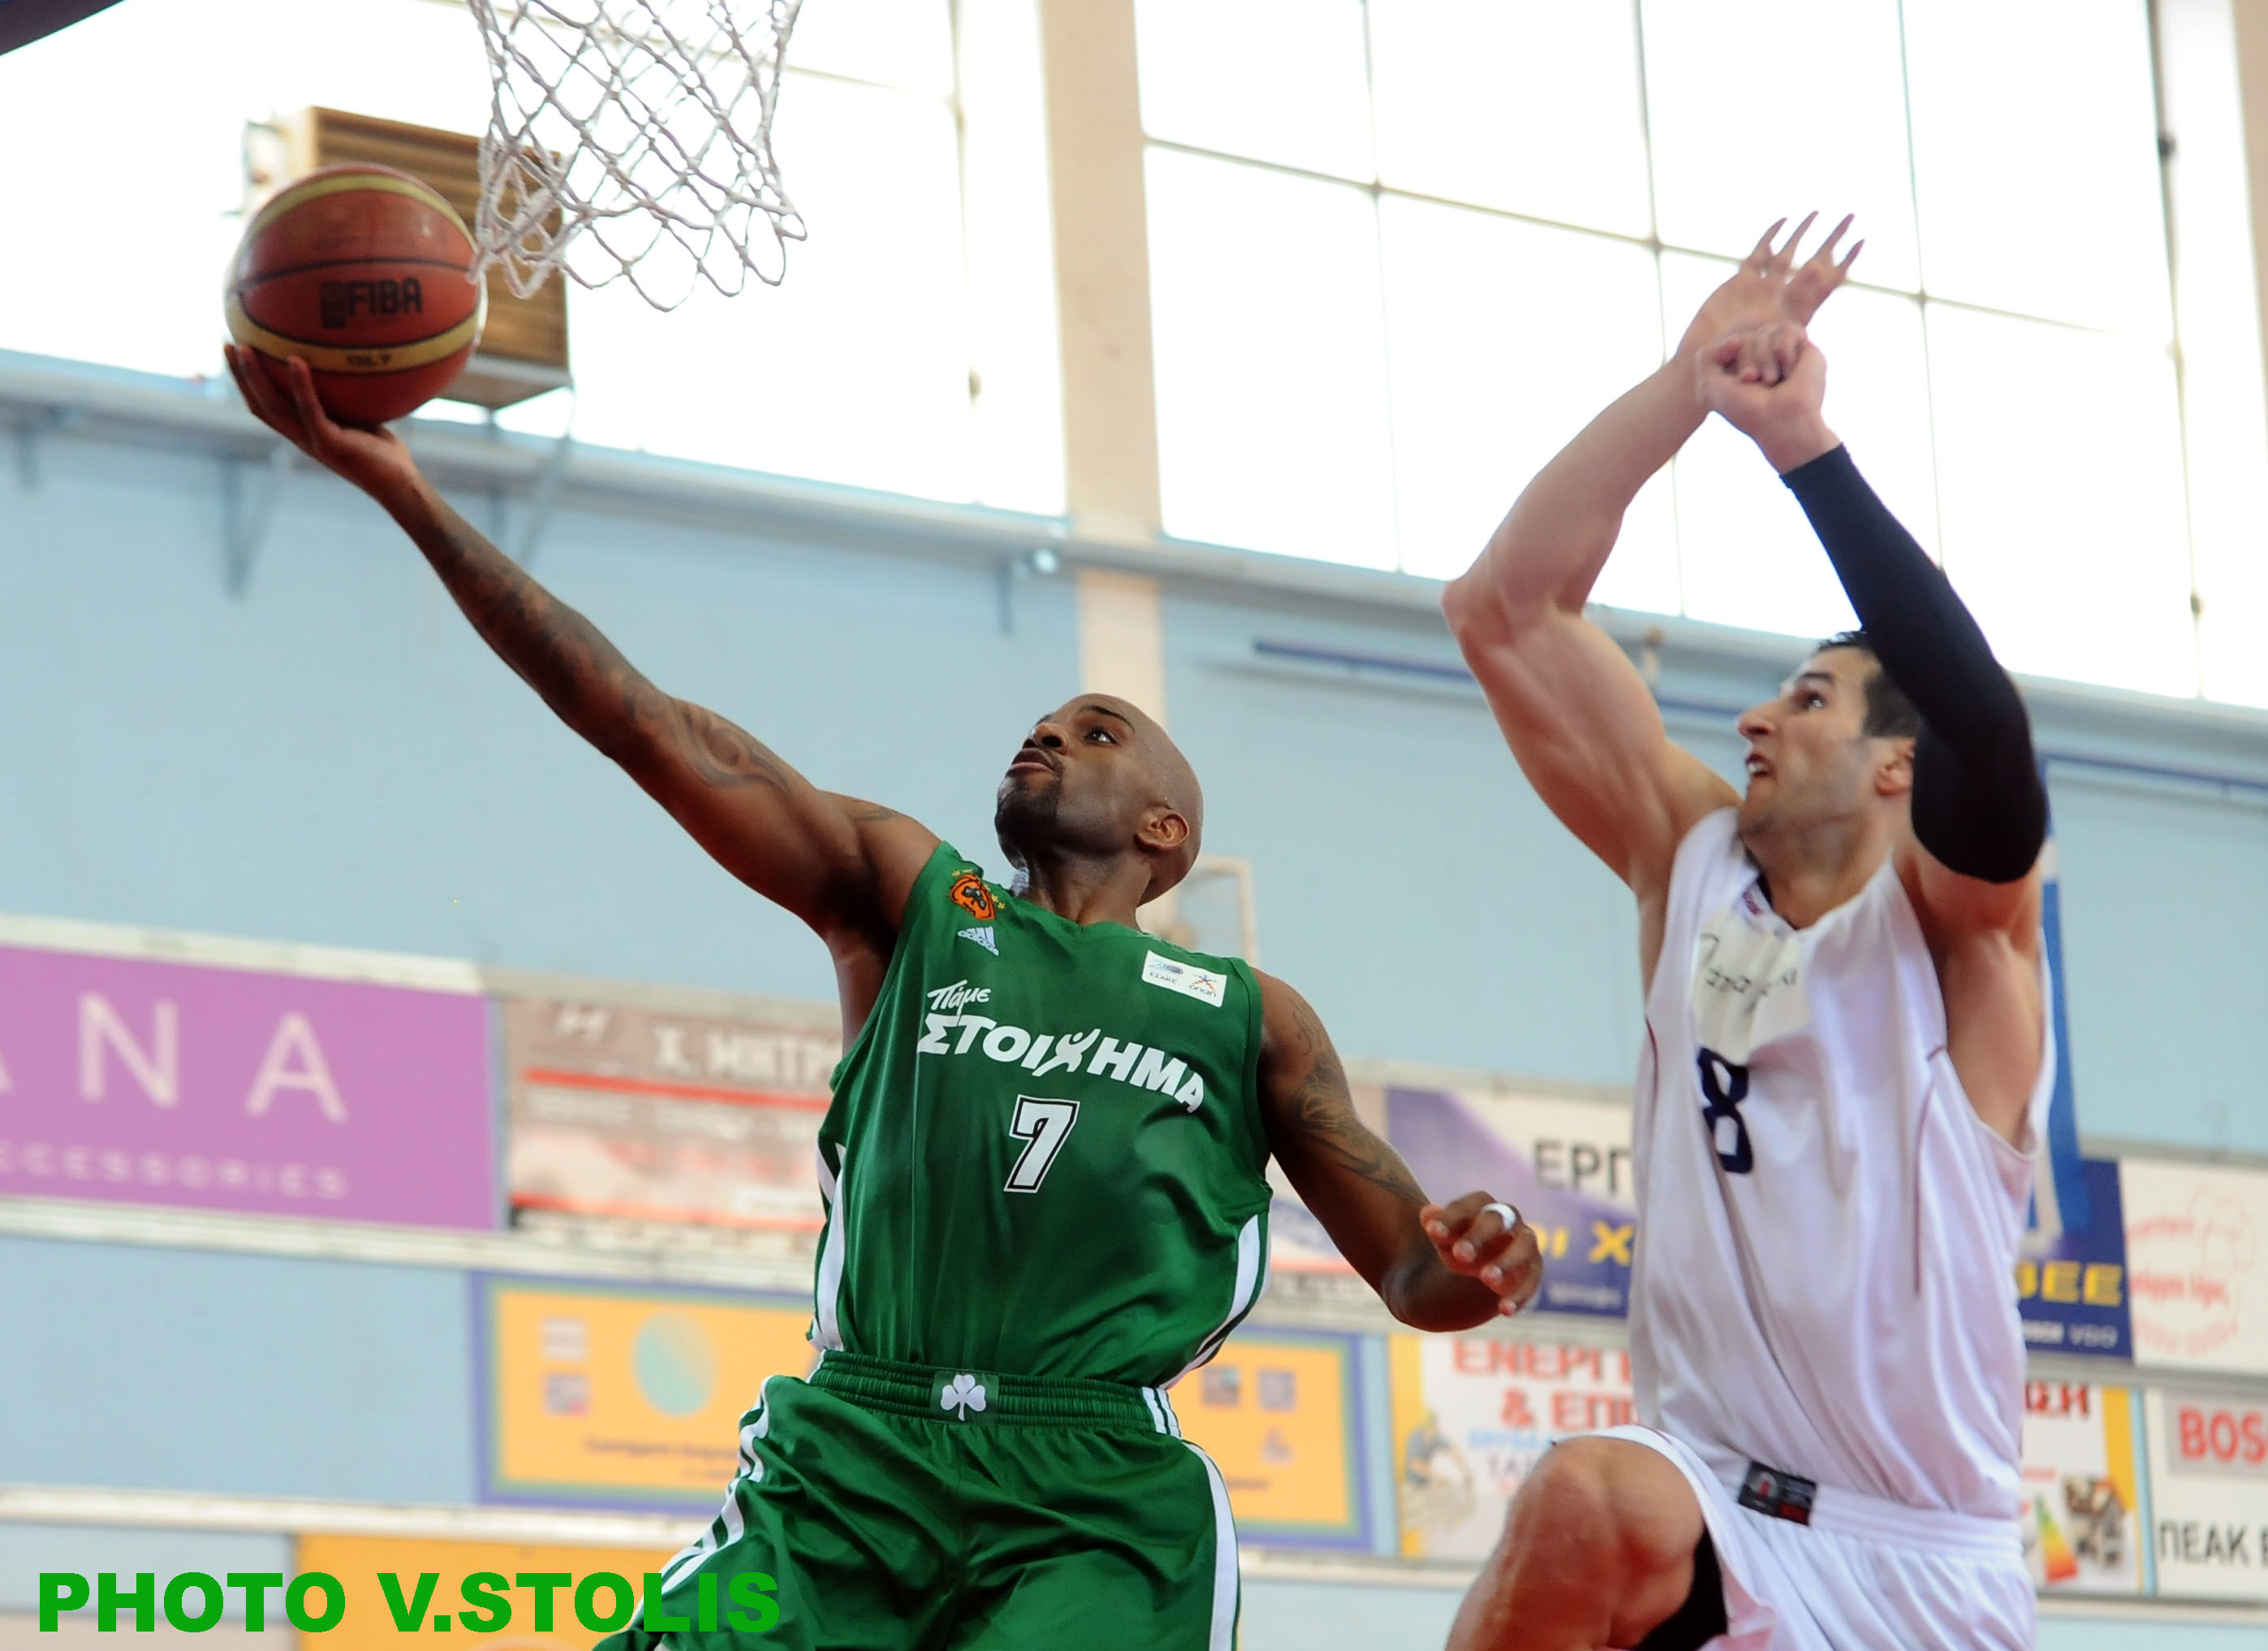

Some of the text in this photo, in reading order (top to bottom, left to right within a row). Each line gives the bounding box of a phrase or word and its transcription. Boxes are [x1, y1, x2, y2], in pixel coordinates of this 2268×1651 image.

[345, 276, 422, 317] FIBA
[958, 930, 999, 956] adidas
[917, 1012, 1205, 1114] ΣΤΟΙΧΗΜΑ
[1697, 1047, 1753, 1175] 8
[1003, 1094, 1080, 1194] 7
[1500, 1387, 1534, 1428] &
[2177, 1406, 2268, 1464] BOS
